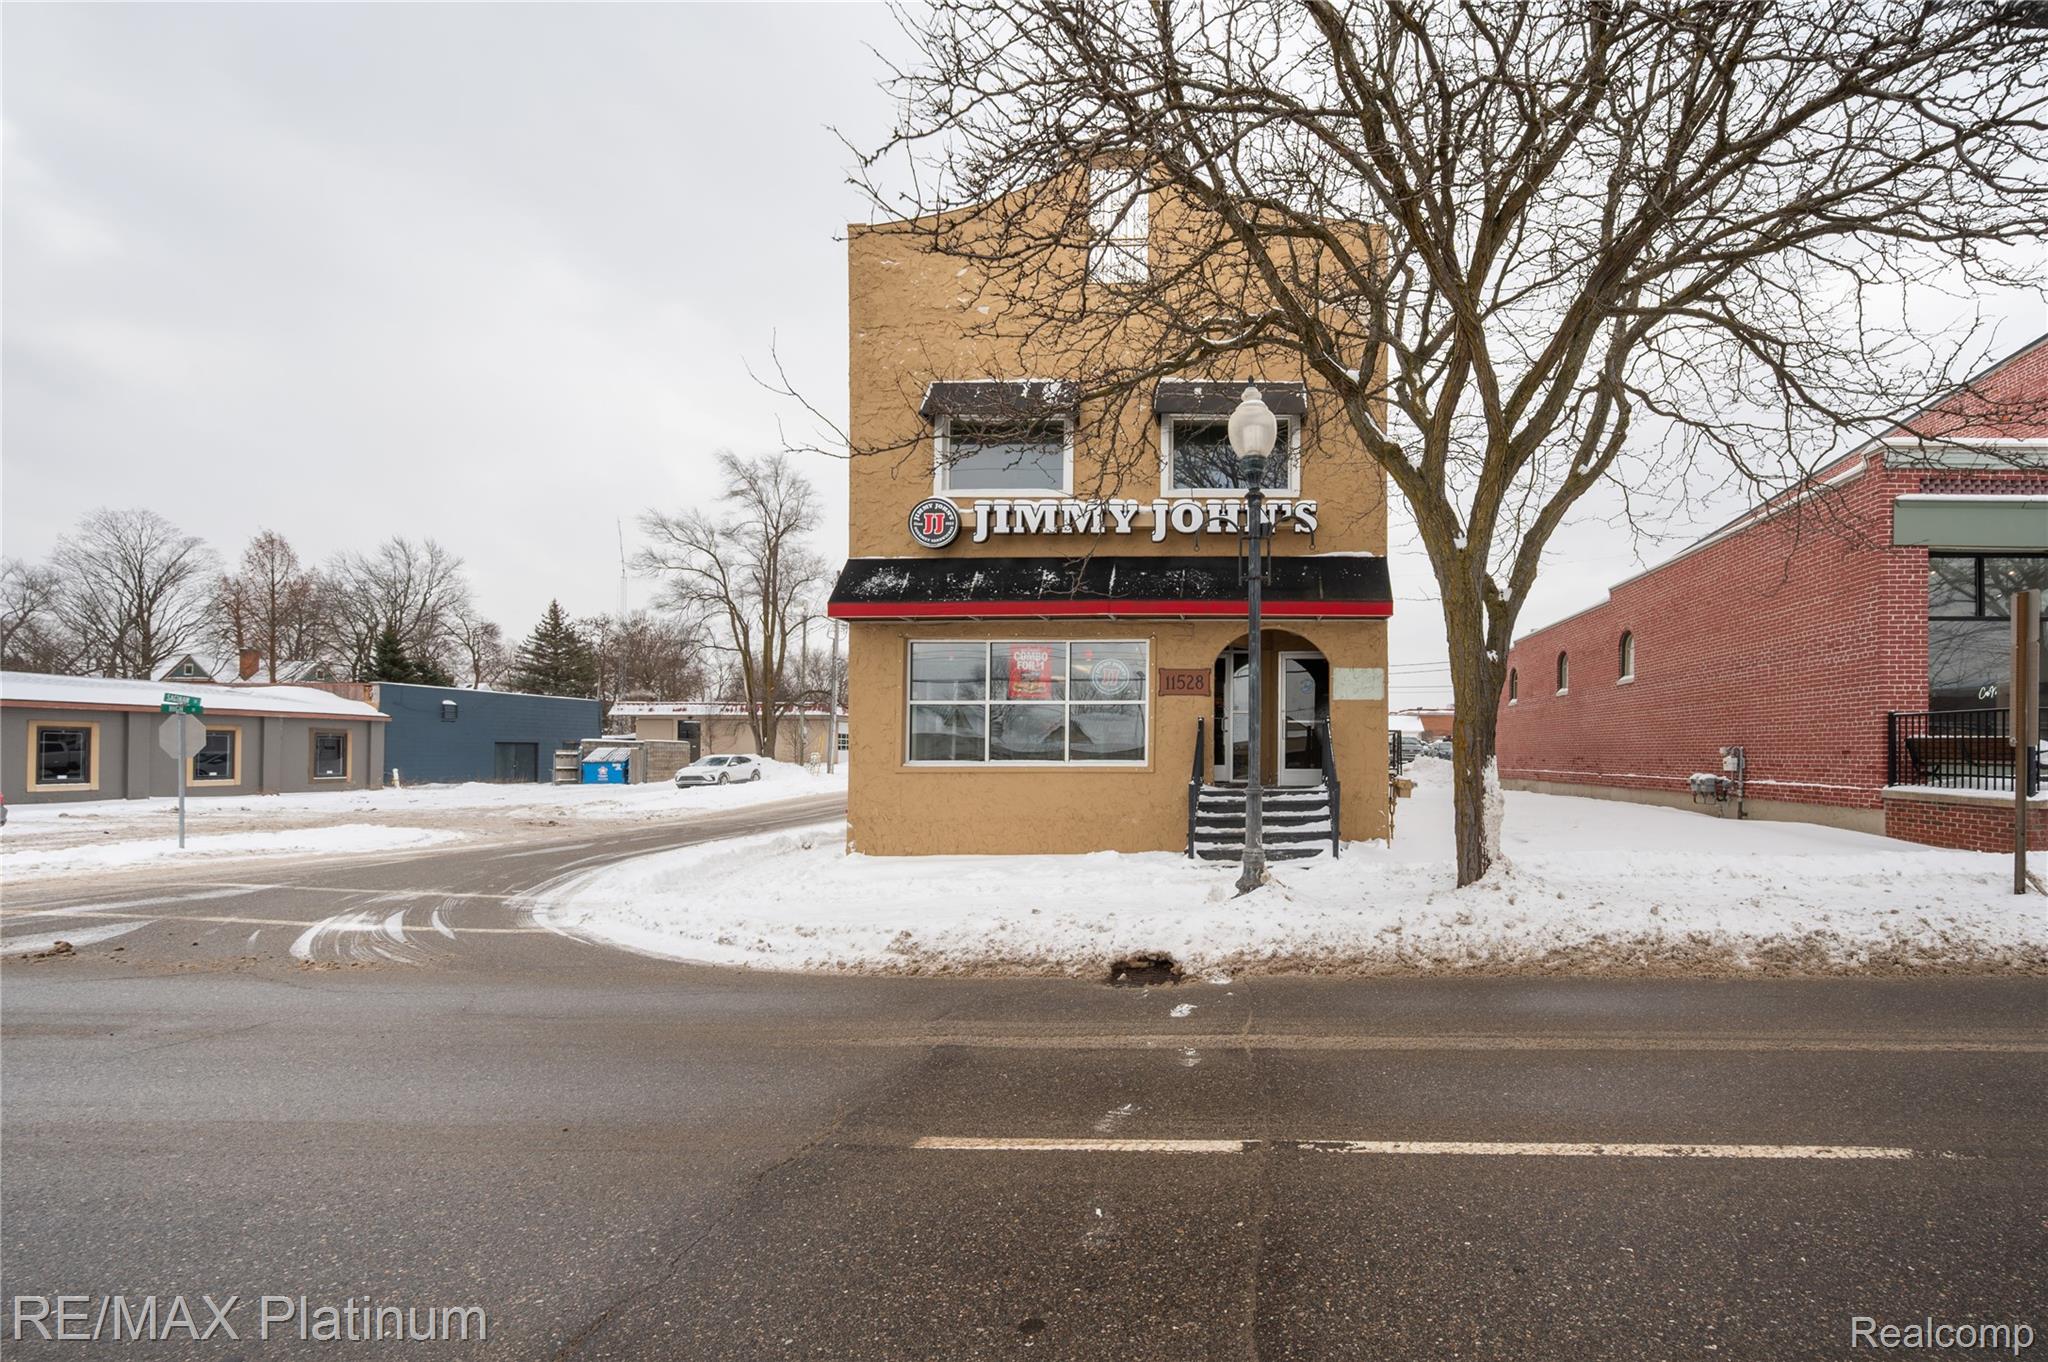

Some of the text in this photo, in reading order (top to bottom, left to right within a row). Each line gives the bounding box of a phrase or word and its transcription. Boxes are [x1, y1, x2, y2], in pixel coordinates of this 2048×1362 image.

[914, 503, 933, 521] JIMMY
[923, 513, 945, 534] JJ
[972, 502, 1318, 543] JIMMY JOHN'S
[1165, 674, 1205, 690] 11528
